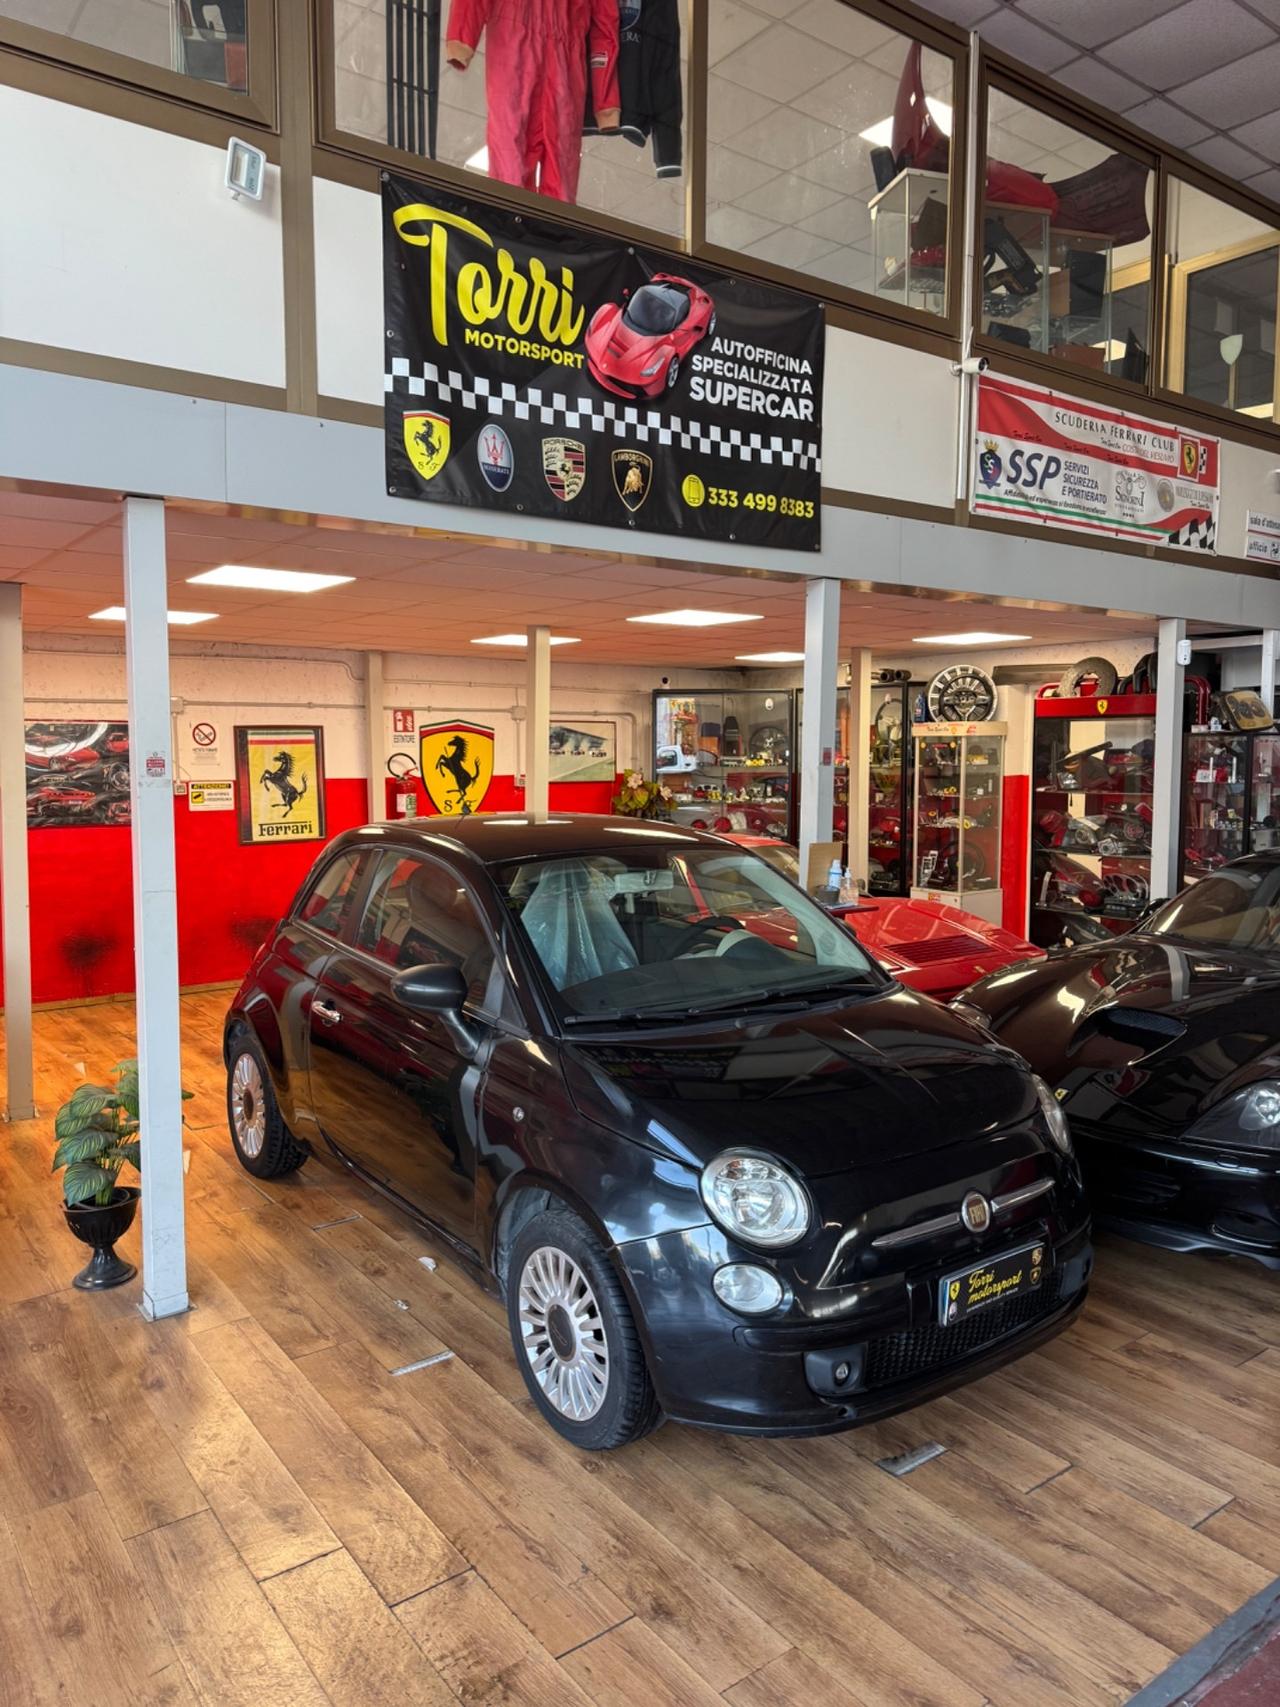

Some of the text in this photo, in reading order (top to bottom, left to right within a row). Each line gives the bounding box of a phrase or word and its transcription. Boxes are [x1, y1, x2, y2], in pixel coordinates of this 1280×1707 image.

[392, 203, 585, 346] Torri
[464, 328, 584, 369] MOTORSPORT
[711, 336, 813, 375] AUTOFFICINA
[691, 354, 814, 395] SPECIALIZZATA
[689, 376, 815, 422] SUPERCAR
[1055, 411, 1107, 434] SCUDERIA
[1110, 425, 1148, 446] FERRARI
[1151, 436, 1175, 452] CLUB
[1006, 449, 1062, 490] SSP
[1063, 460, 1090, 476] SERVIZI
[1063, 473, 1100, 490] SICUREZZA
[707, 487, 815, 518] 333 499 8383
[1061, 486, 1108, 504] E PORTIERATO
[258, 821, 313, 836] Ferrari
[969, 1203, 986, 1225] FIAT
[967, 1269, 1023, 1305] motorsport
[968, 1268, 996, 1293] Torri
